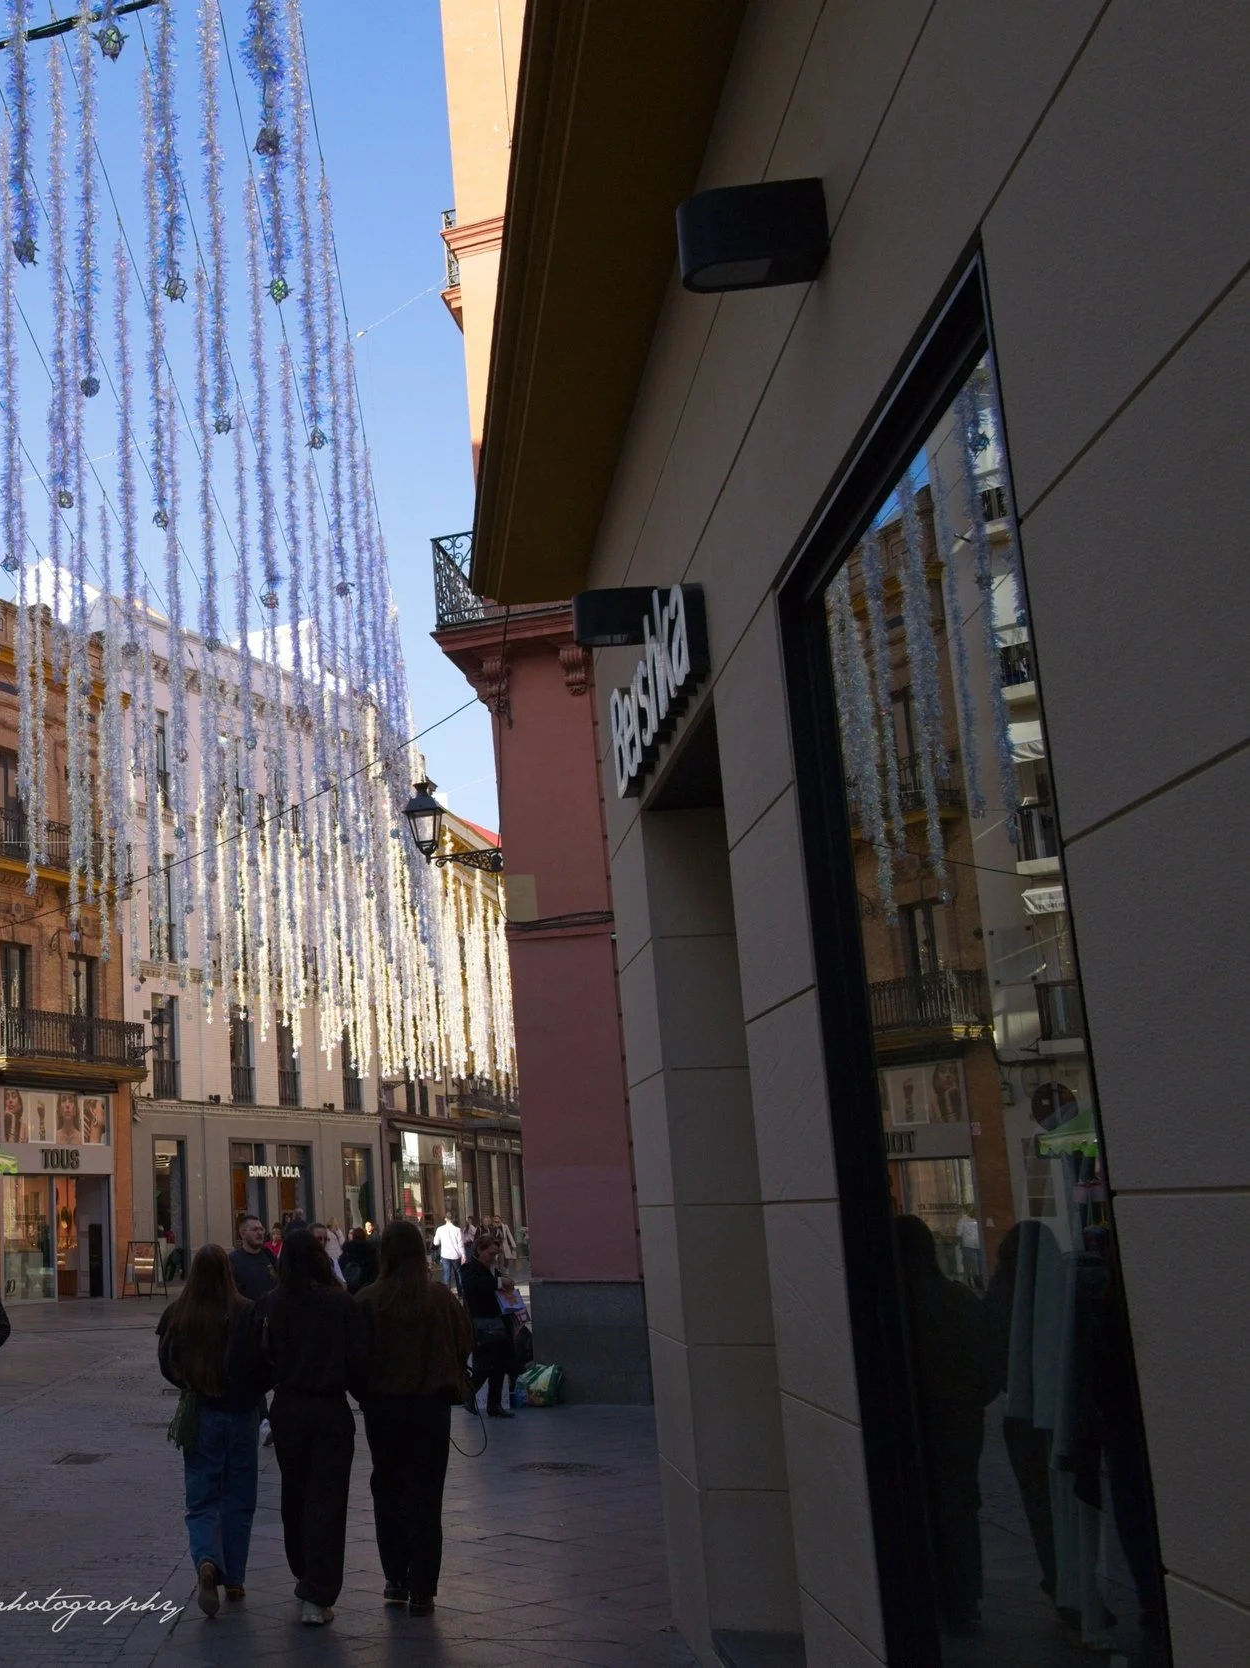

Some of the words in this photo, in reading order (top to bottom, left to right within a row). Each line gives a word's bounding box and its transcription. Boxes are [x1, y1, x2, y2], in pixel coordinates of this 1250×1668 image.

[610, 584, 690, 798] Bershka
[39, 1148, 80, 1170] TOUS
[248, 1165, 273, 1177] BIMBA
[273, 1165, 280, 1178] Y
[281, 1166, 301, 1178] LOLA
